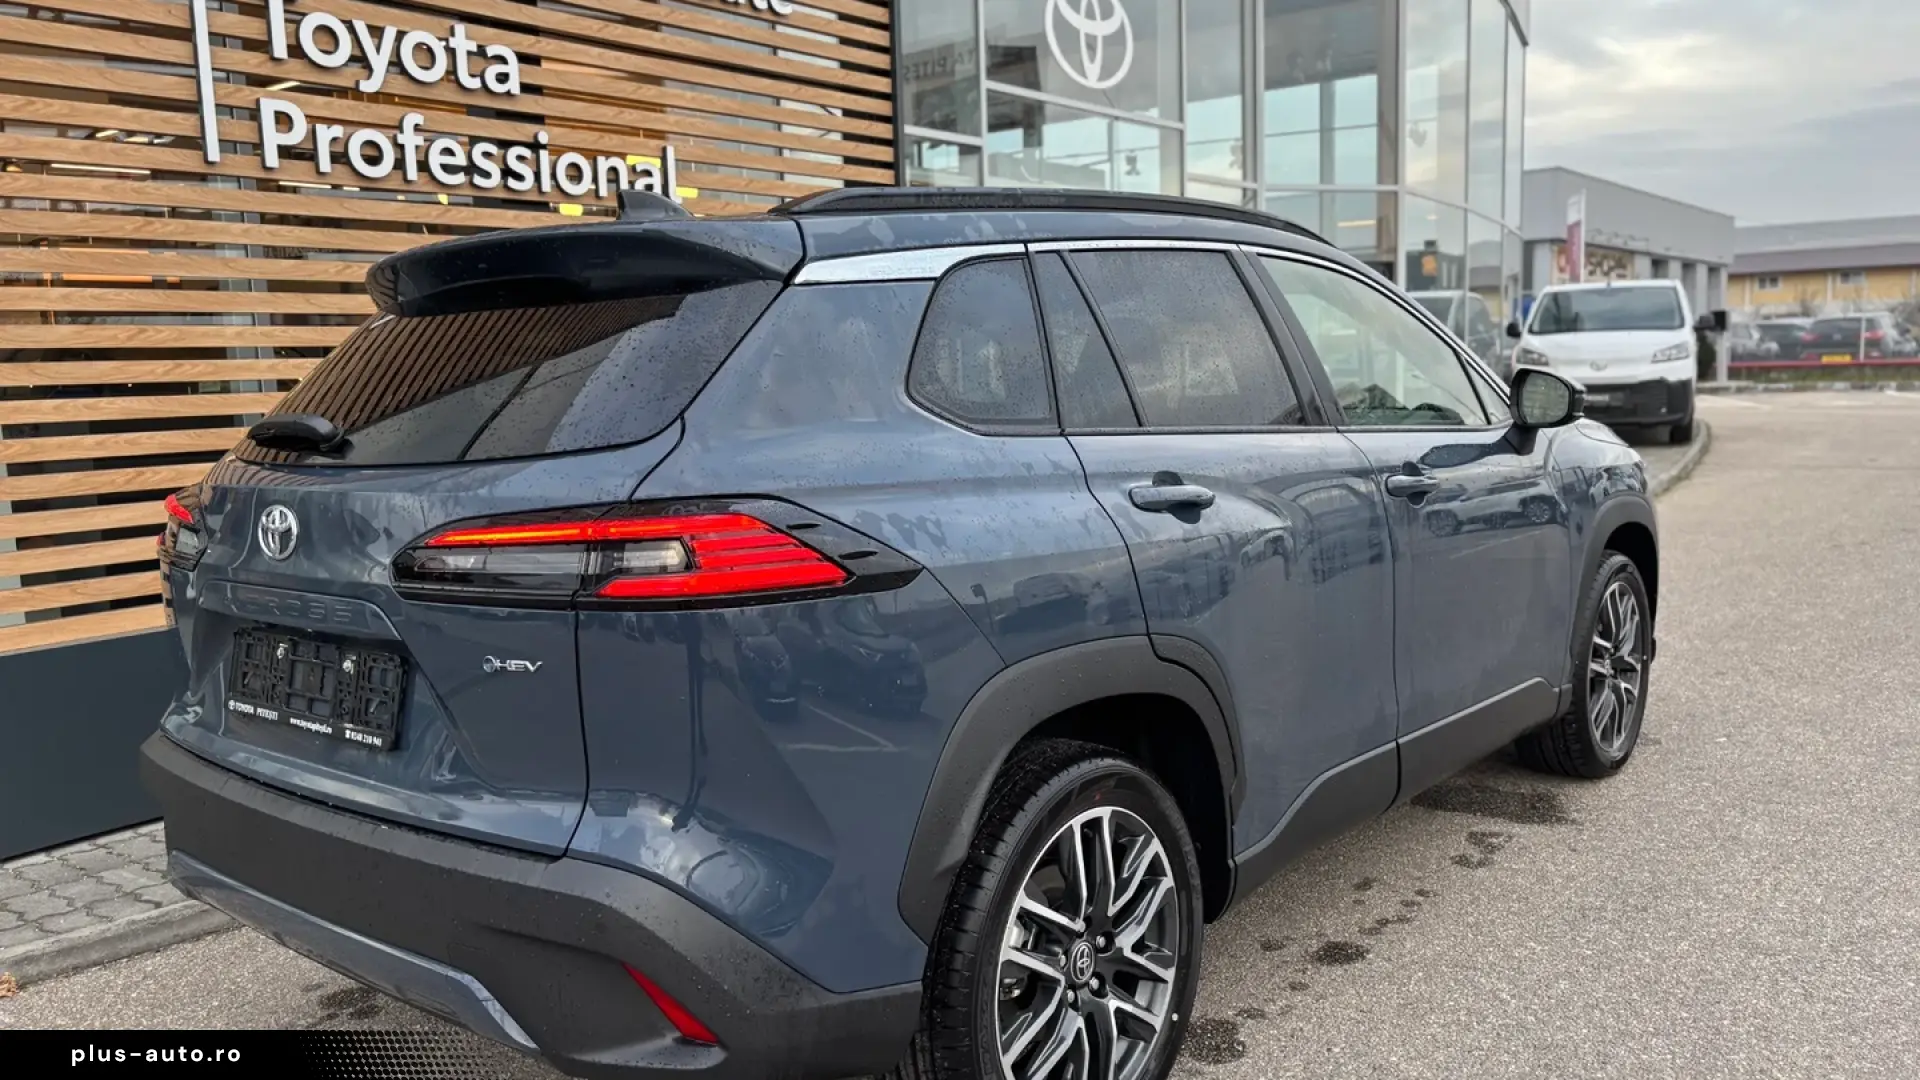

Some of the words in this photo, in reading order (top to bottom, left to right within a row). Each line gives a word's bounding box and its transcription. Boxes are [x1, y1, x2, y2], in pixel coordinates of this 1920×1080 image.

[268, 0, 520, 95] Toyota
[260, 97, 682, 204] Professional
[496, 659, 543, 672] HEV
